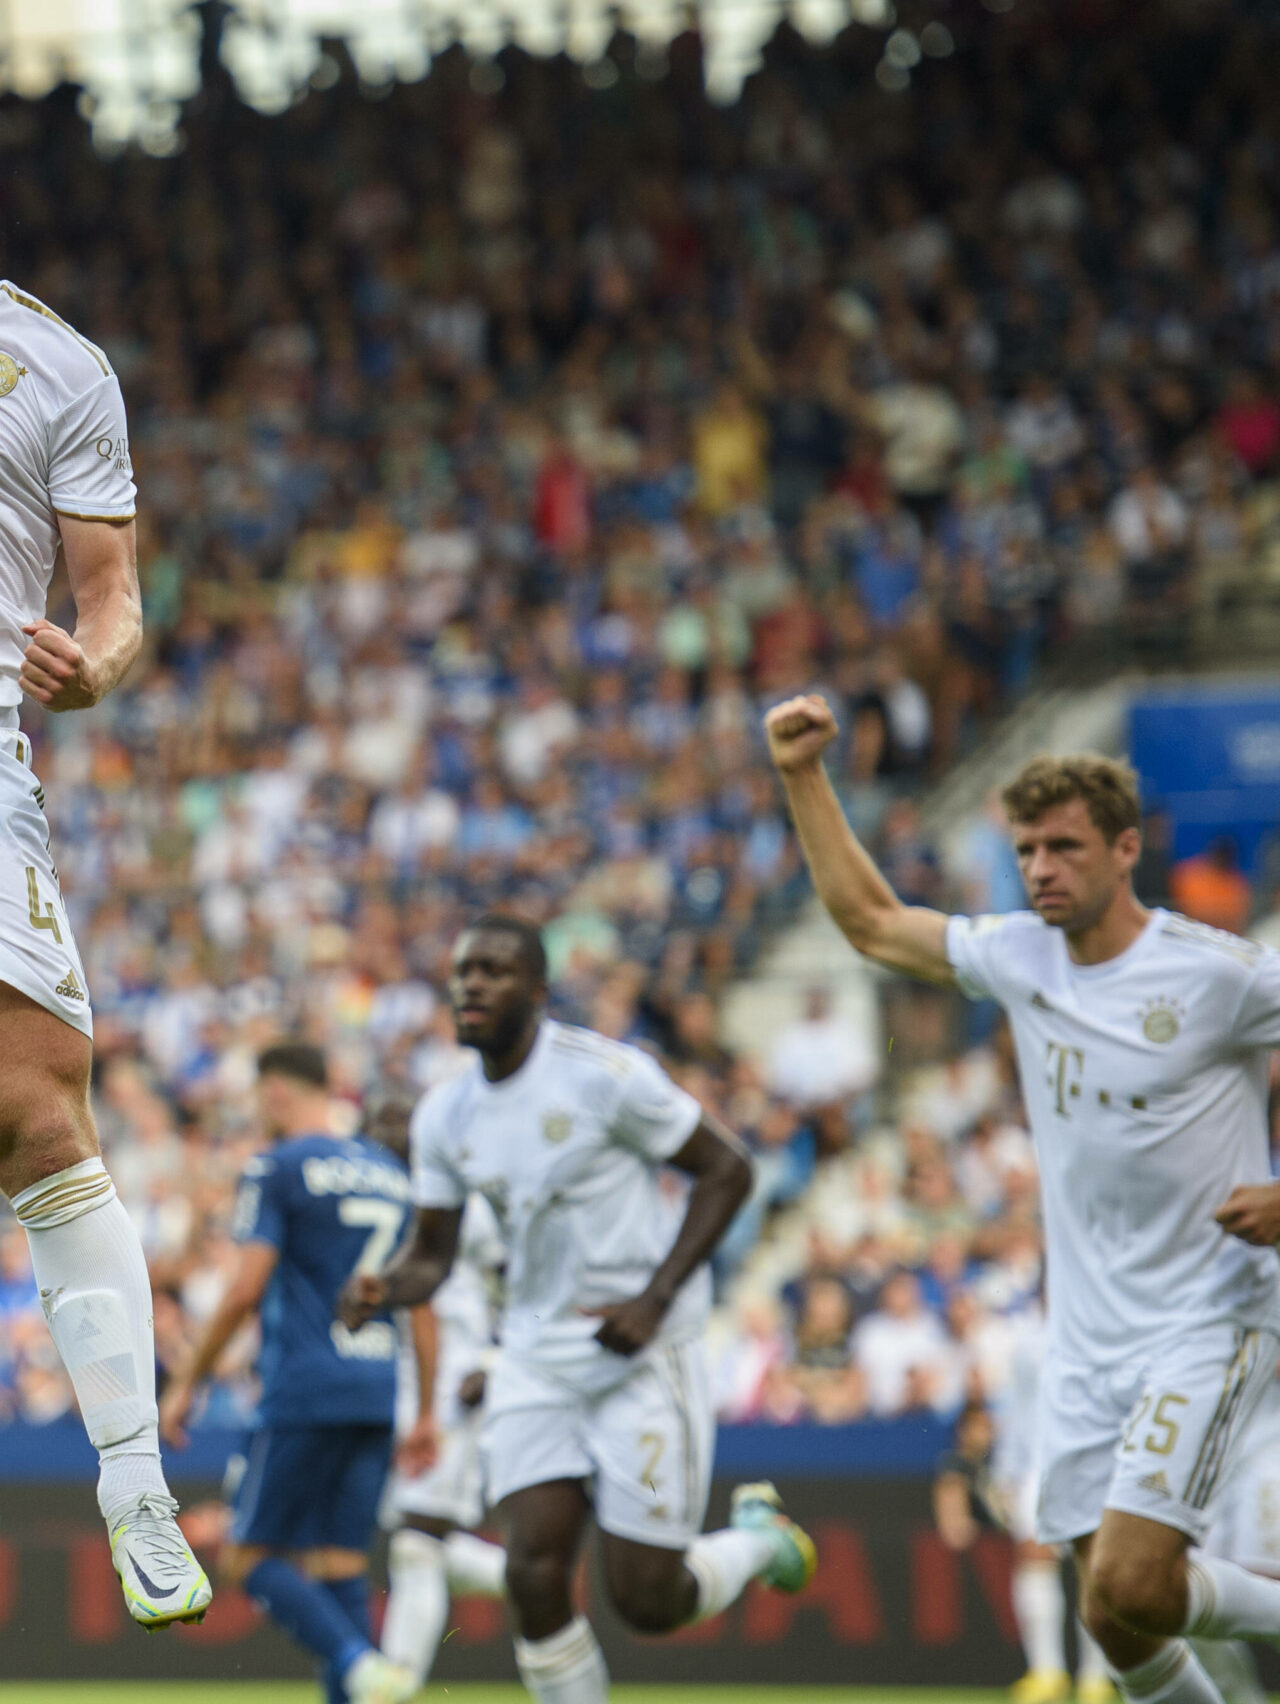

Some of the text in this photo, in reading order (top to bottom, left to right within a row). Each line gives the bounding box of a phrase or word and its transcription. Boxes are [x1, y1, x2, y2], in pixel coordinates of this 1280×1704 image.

[25, 866, 63, 945] 4
[55, 985, 85, 1002] adidas
[337, 1197, 404, 1280] 7
[638, 1431, 666, 1488] 2
